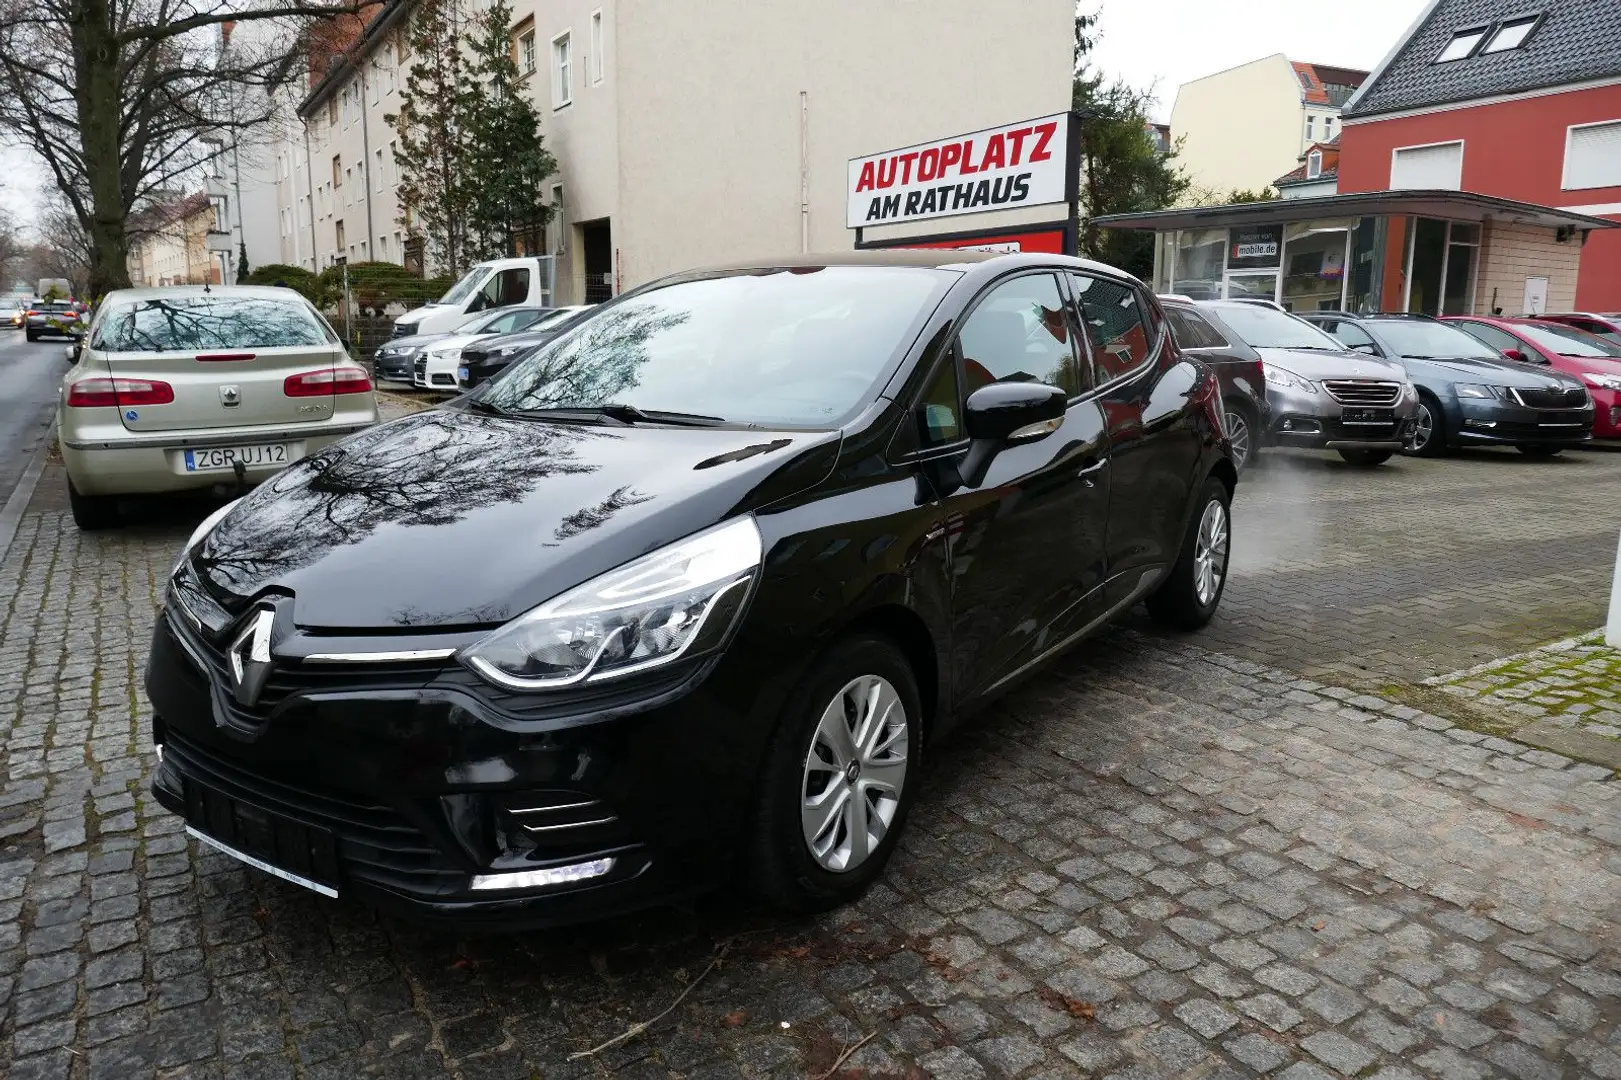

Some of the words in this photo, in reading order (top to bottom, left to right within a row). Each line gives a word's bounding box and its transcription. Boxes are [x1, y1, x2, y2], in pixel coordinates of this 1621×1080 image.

[856, 122, 1057, 192] AUTOPLATZ
[867, 194, 901, 220] AM
[904, 173, 1032, 216] RATHAUS
[1239, 245, 1276, 255] mobile.de
